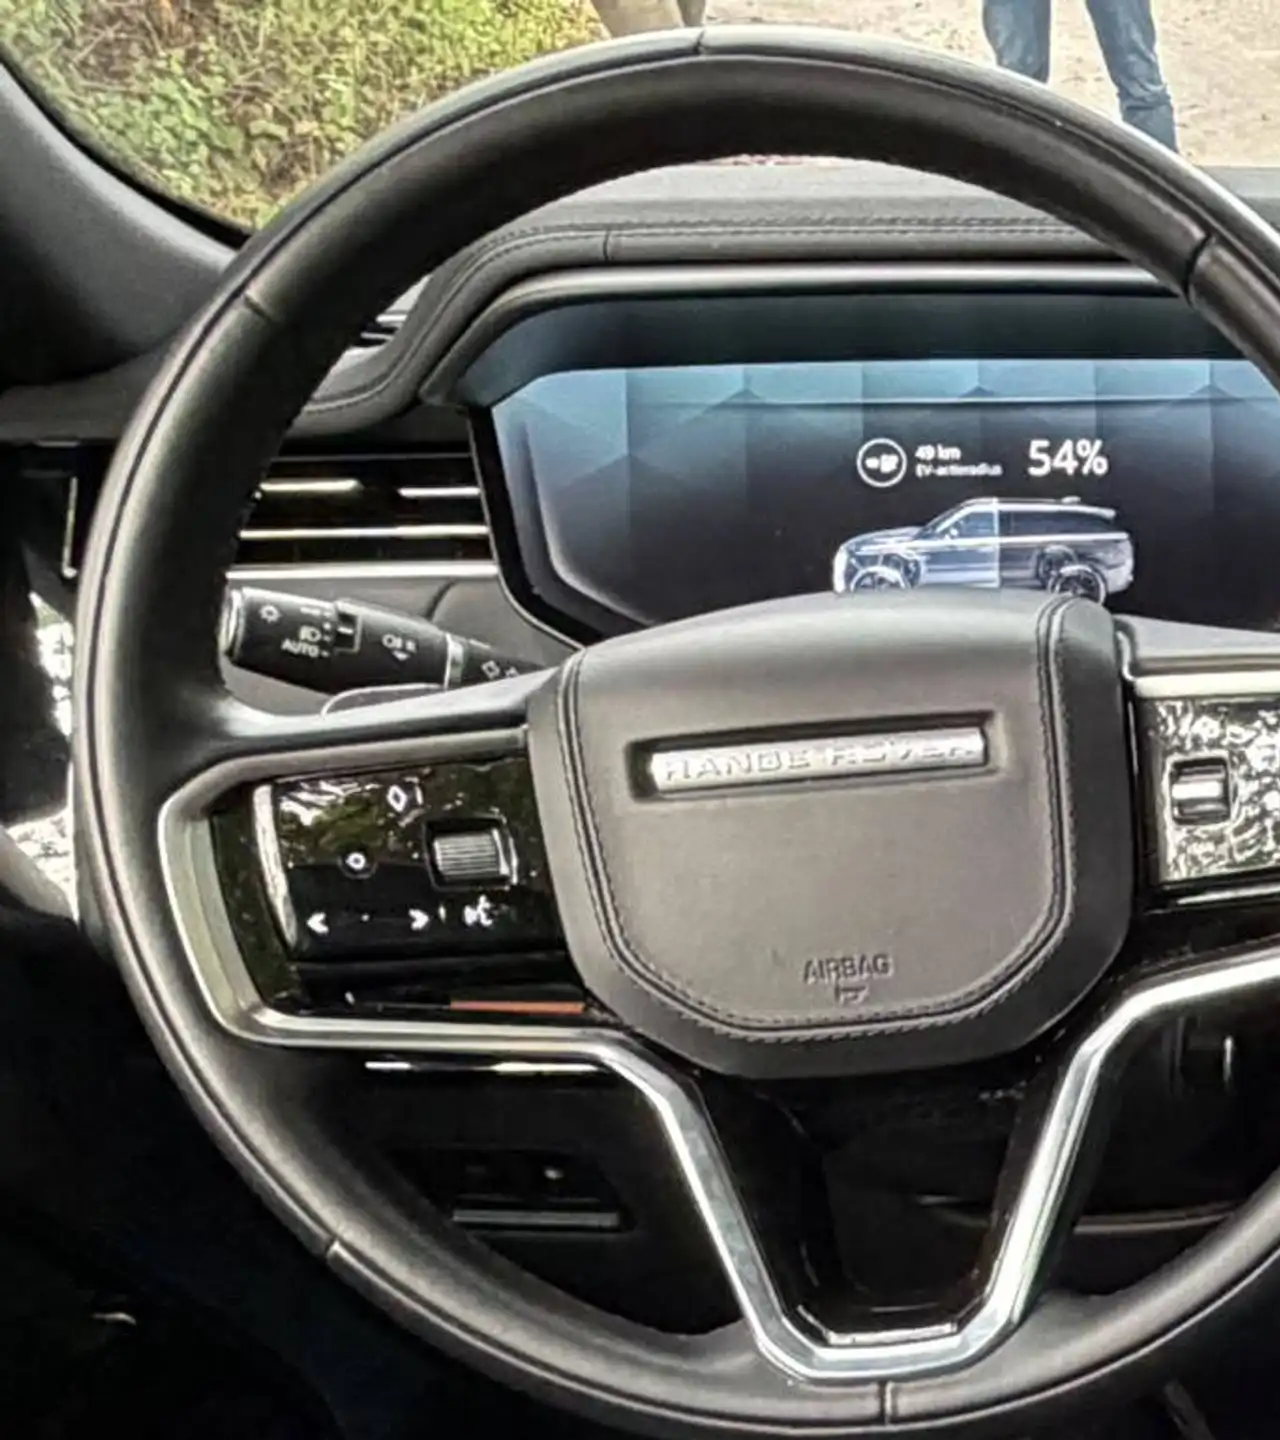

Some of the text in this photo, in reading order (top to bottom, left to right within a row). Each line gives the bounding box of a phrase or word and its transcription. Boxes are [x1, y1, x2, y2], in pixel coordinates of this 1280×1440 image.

[937, 444, 962, 460] km
[1028, 438, 1109, 477] 54%
[280, 637, 320, 658] AUTO
[666, 751, 811, 782] RANGE
[803, 953, 894, 985] AIRBAG
